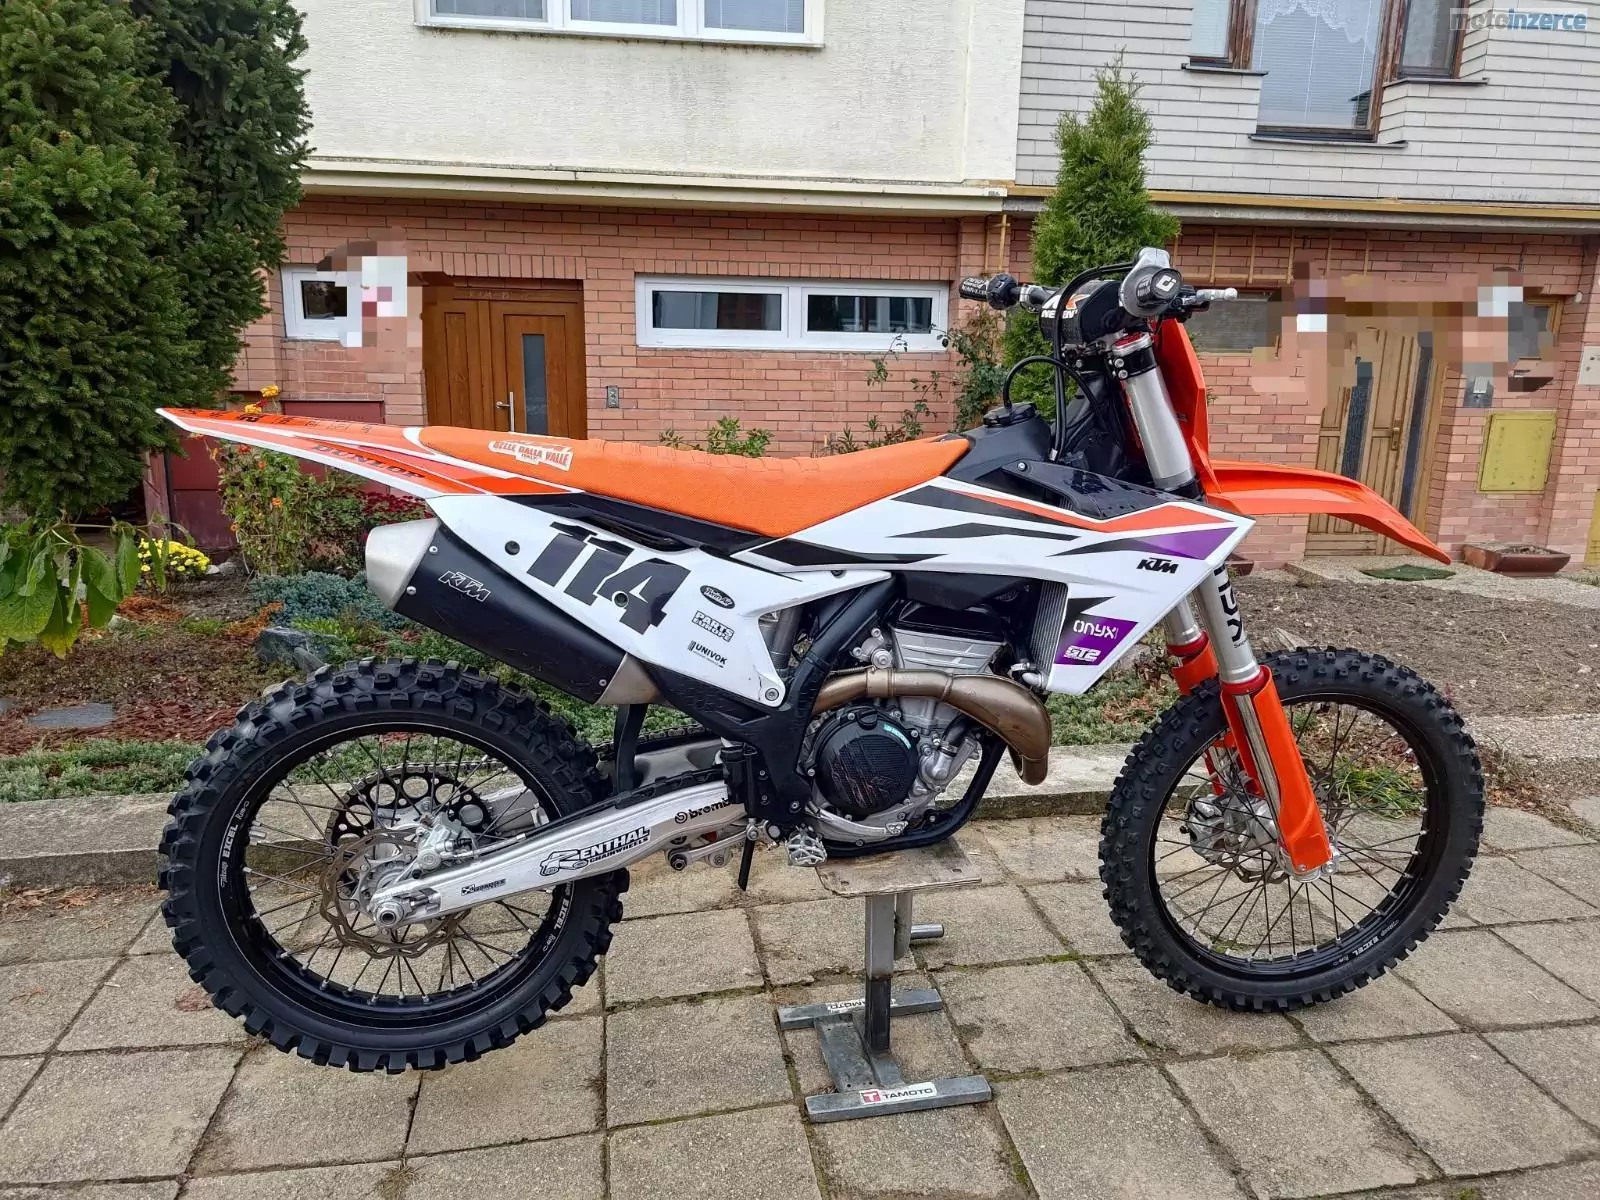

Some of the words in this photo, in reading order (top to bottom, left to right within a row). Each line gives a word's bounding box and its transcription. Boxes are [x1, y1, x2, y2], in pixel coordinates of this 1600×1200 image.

[1041, 309, 1076, 319] NEEN
[312, 444, 426, 478] DUNLOP
[1136, 557, 1179, 574] KTM
[439, 570, 491, 602] KTM
[526, 521, 692, 635] 114
[694, 610, 735, 637] PARTS
[696, 643, 728, 665] UNIVOK
[688, 797, 731, 819] bremb
[222, 824, 239, 858] EXCEL
[554, 898, 570, 930] EXCEL
[1352, 935, 1379, 956] EXCEL
[883, 1087, 933, 1099] TAMOTO
